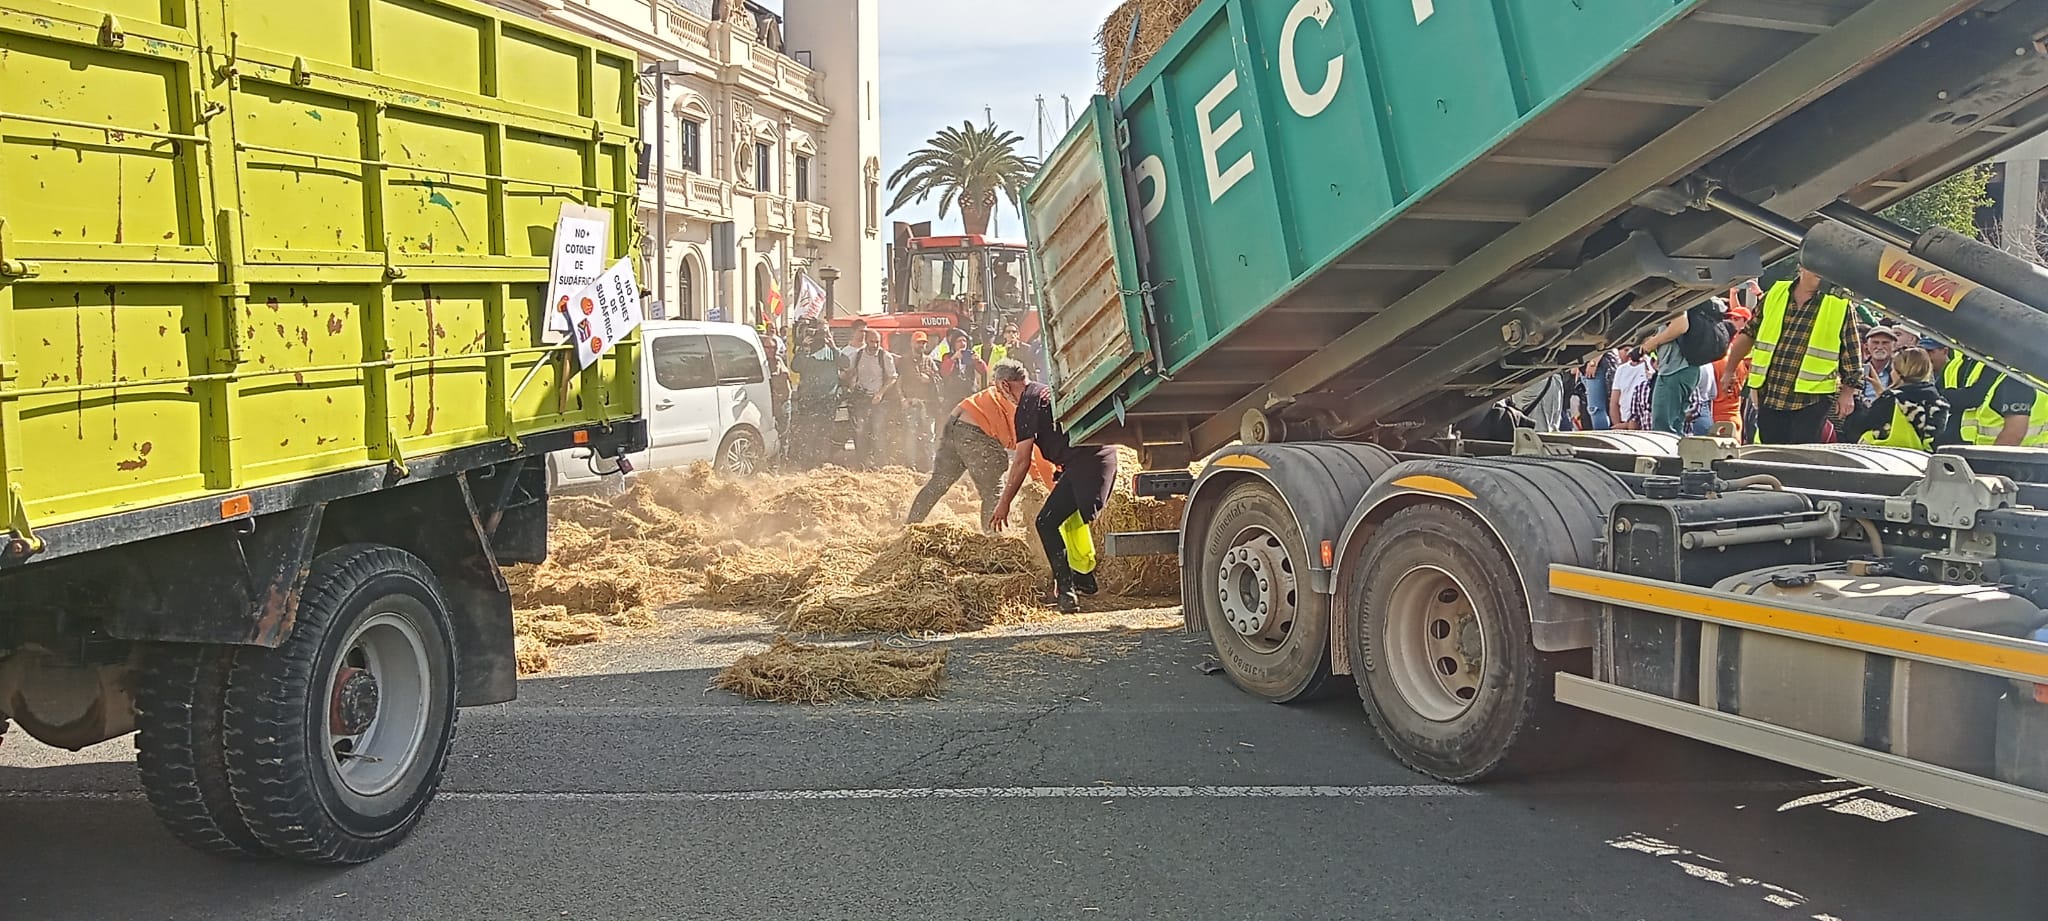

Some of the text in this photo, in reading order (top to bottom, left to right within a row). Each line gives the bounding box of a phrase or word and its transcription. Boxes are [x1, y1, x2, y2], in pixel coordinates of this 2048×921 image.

[565, 244, 595, 255] COTONET
[575, 260, 584, 270] DE
[1885, 260, 1959, 304] HYVA
[610, 298, 618, 315] DE
[614, 275, 630, 322] COTONET
[596, 283, 614, 343] SUDÁFRICA
[921, 317, 950, 326] KUBOTA
